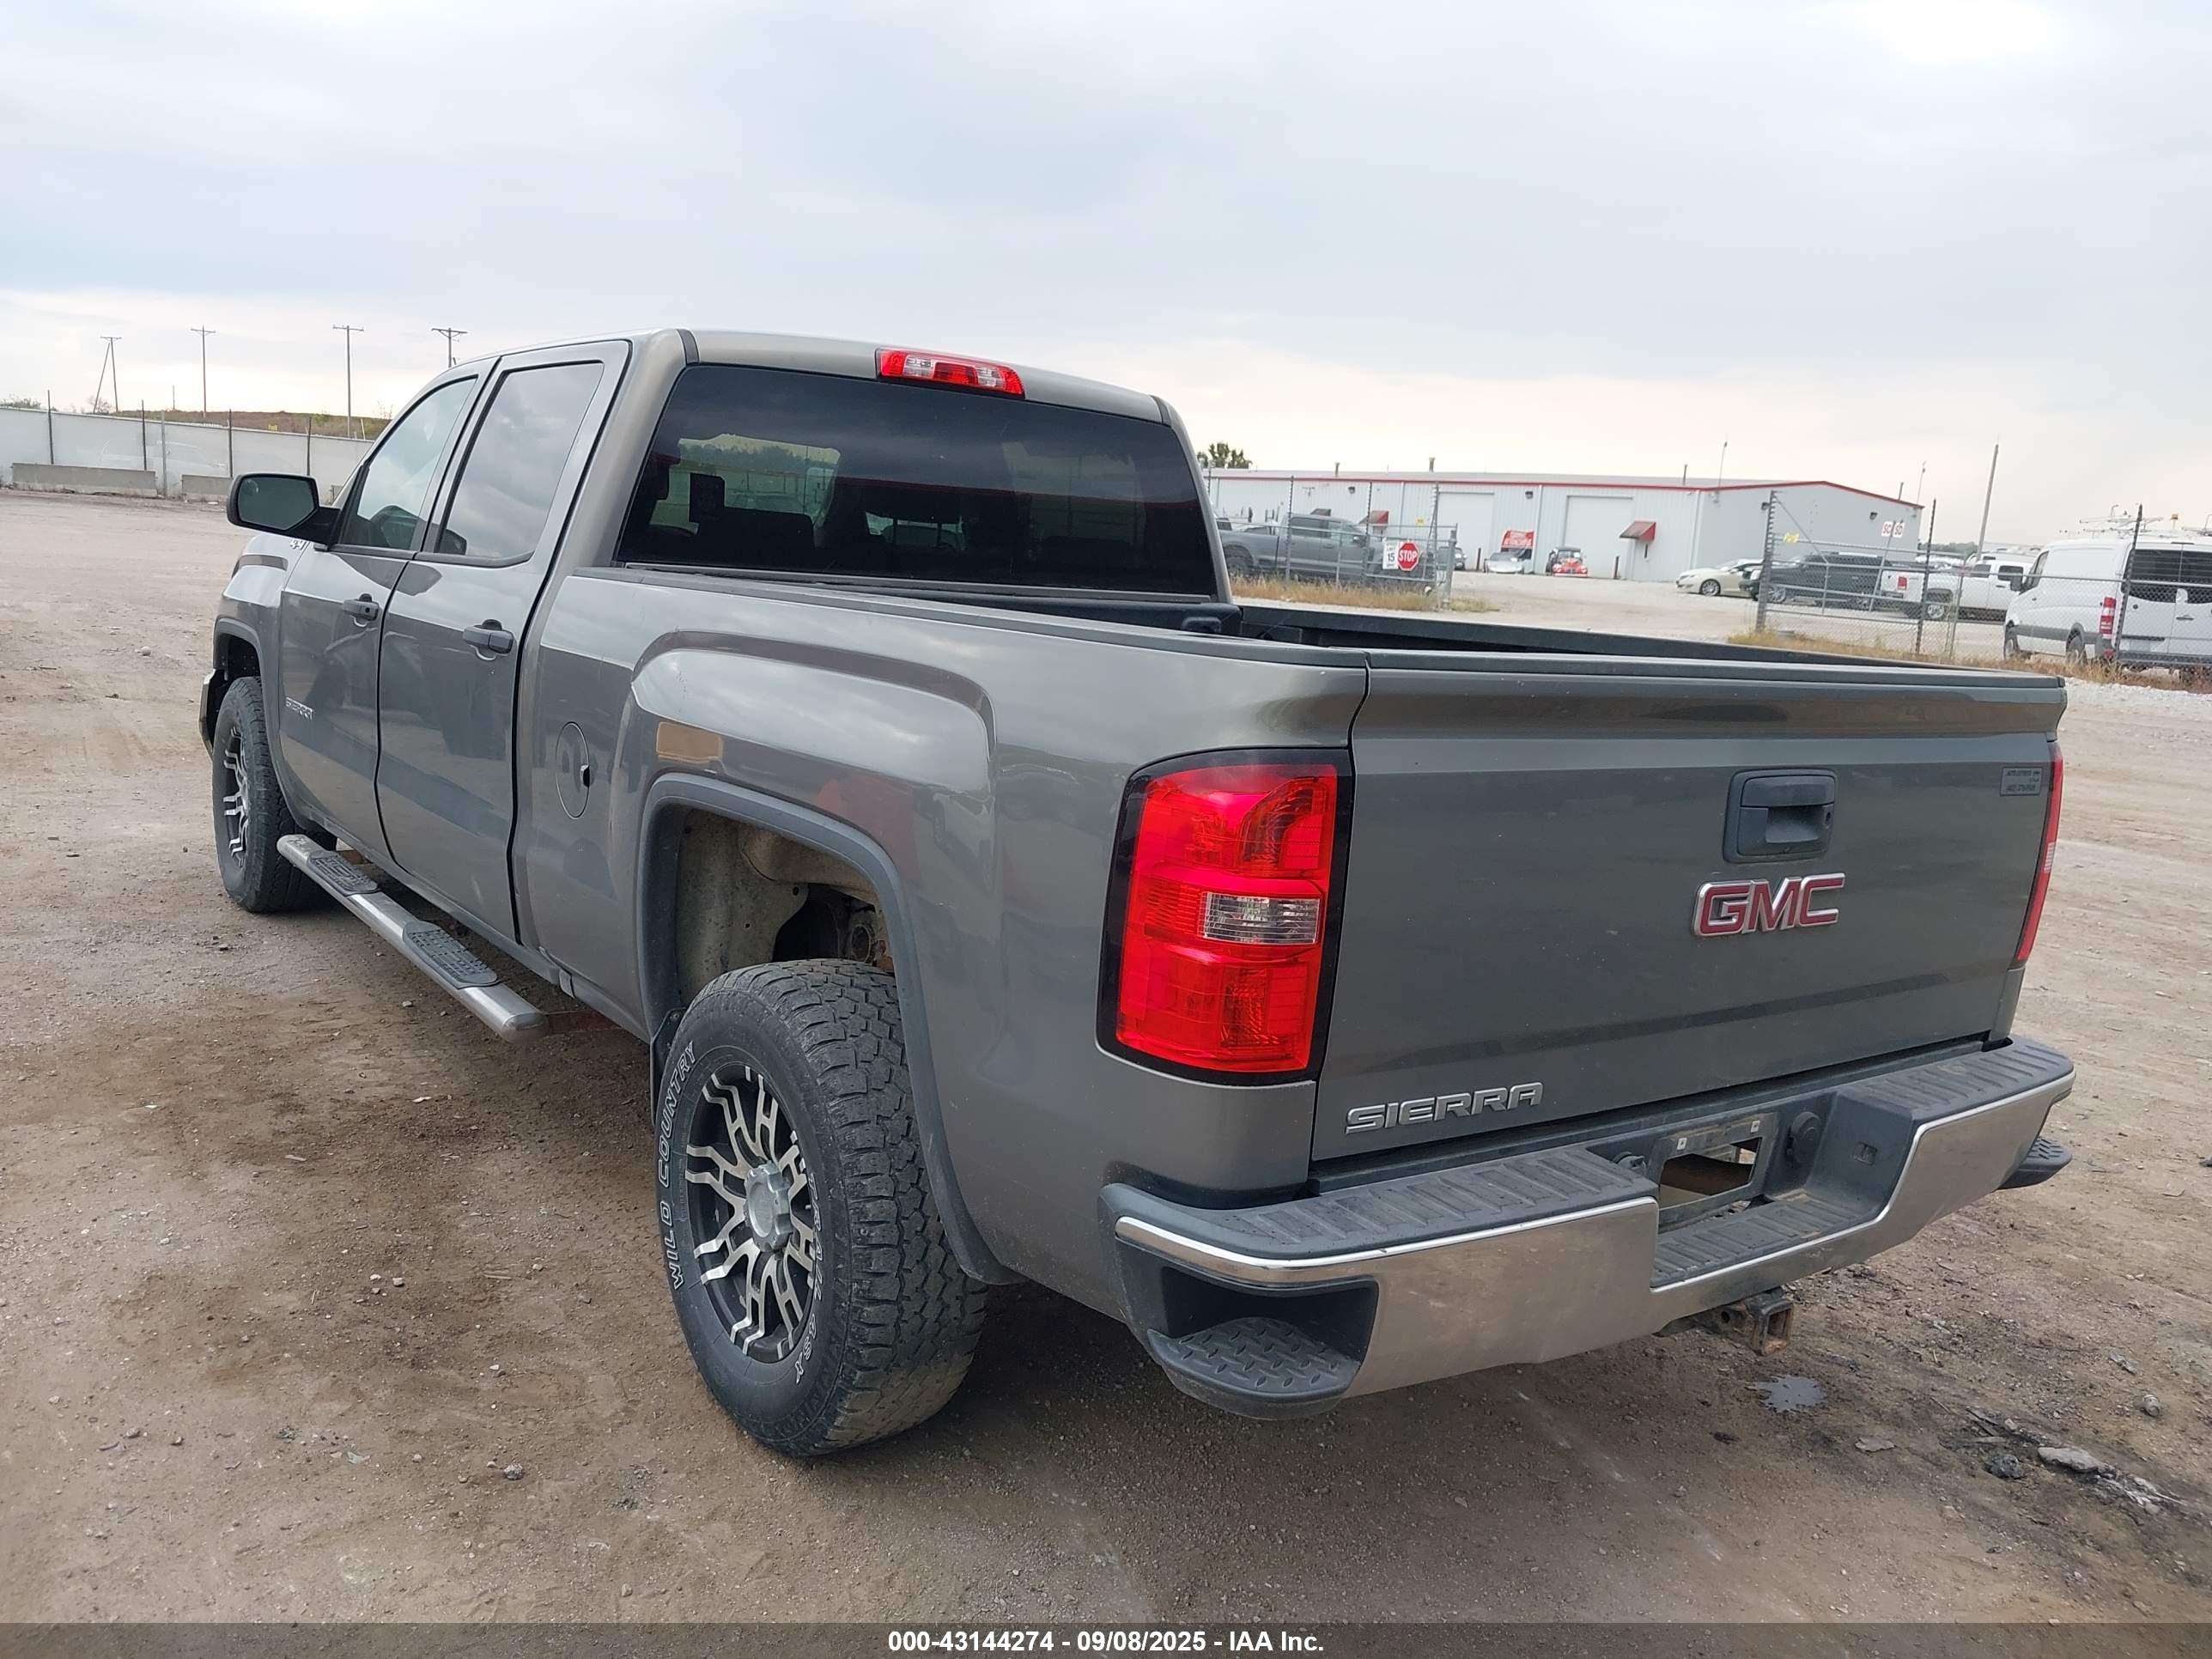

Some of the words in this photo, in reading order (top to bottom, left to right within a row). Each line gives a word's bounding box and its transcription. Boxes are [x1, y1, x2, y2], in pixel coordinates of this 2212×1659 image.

[1388, 553, 1395, 562] 15
[1399, 550, 1418, 562] STOP
[1693, 872, 1845, 937] GMC
[659, 1040, 696, 1188] COUNTRY
[1345, 1082, 1543, 1134] SIERRA
[659, 1200, 684, 1290] WILD
